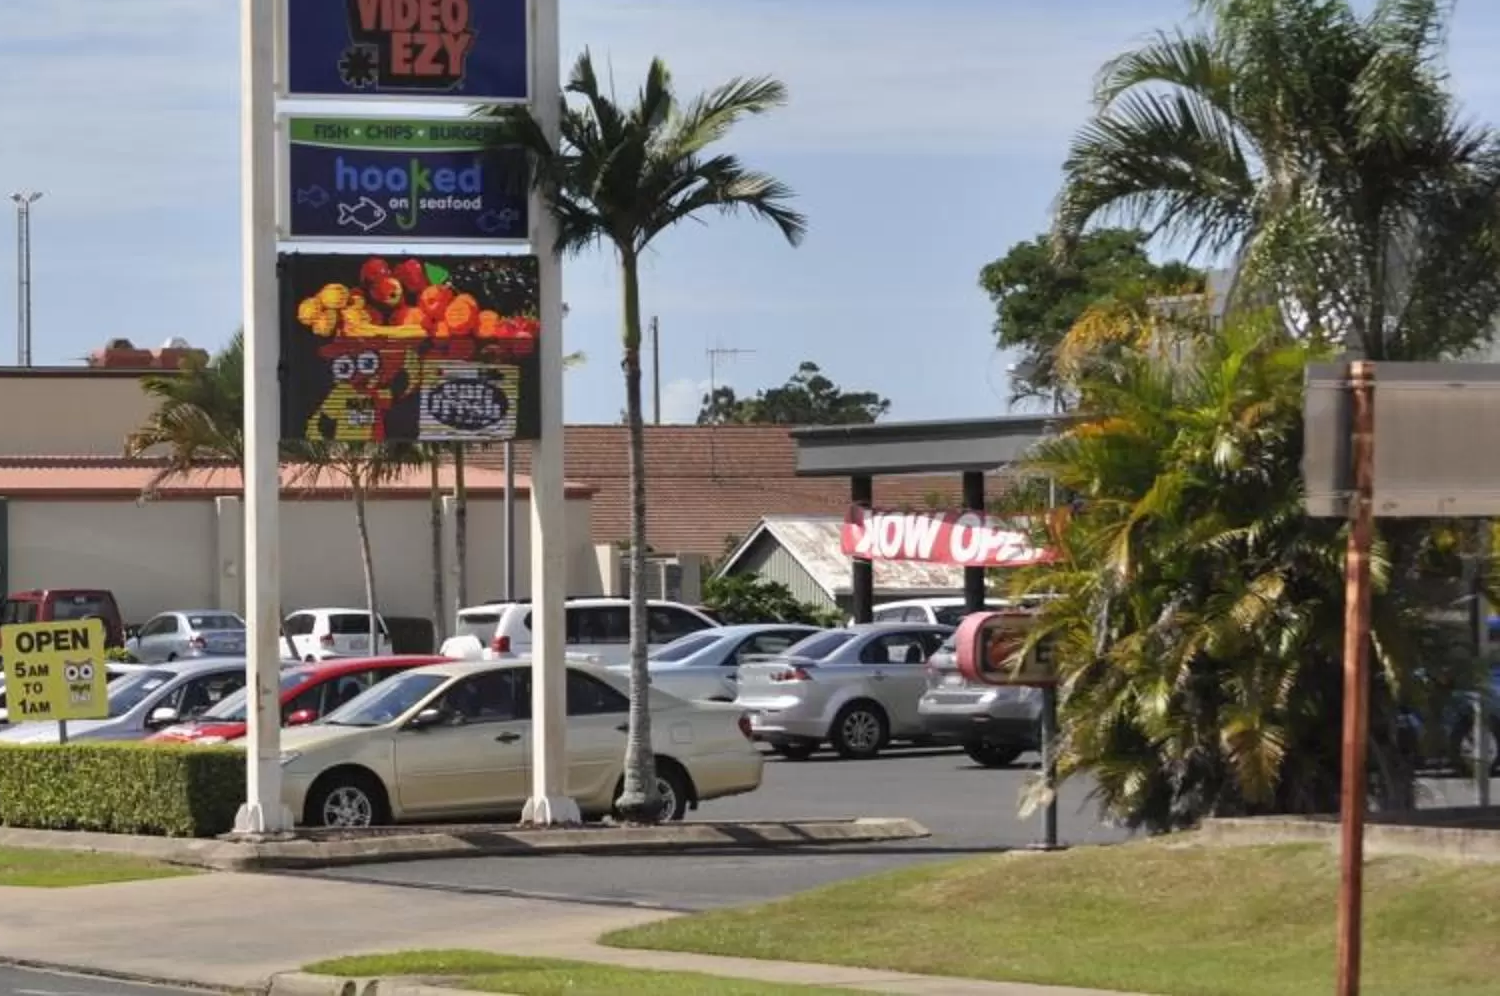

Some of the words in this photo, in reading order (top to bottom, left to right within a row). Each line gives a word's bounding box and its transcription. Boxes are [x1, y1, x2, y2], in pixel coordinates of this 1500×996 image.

[391, 30, 471, 76] EZY
[314, 124, 349, 140] FISH
[365, 124, 414, 141] CHIPS
[335, 155, 484, 192] hooked
[389, 197, 409, 210] on
[419, 195, 483, 210] seafood
[15, 627, 90, 654] OPEN
[23, 682, 44, 695] TO
